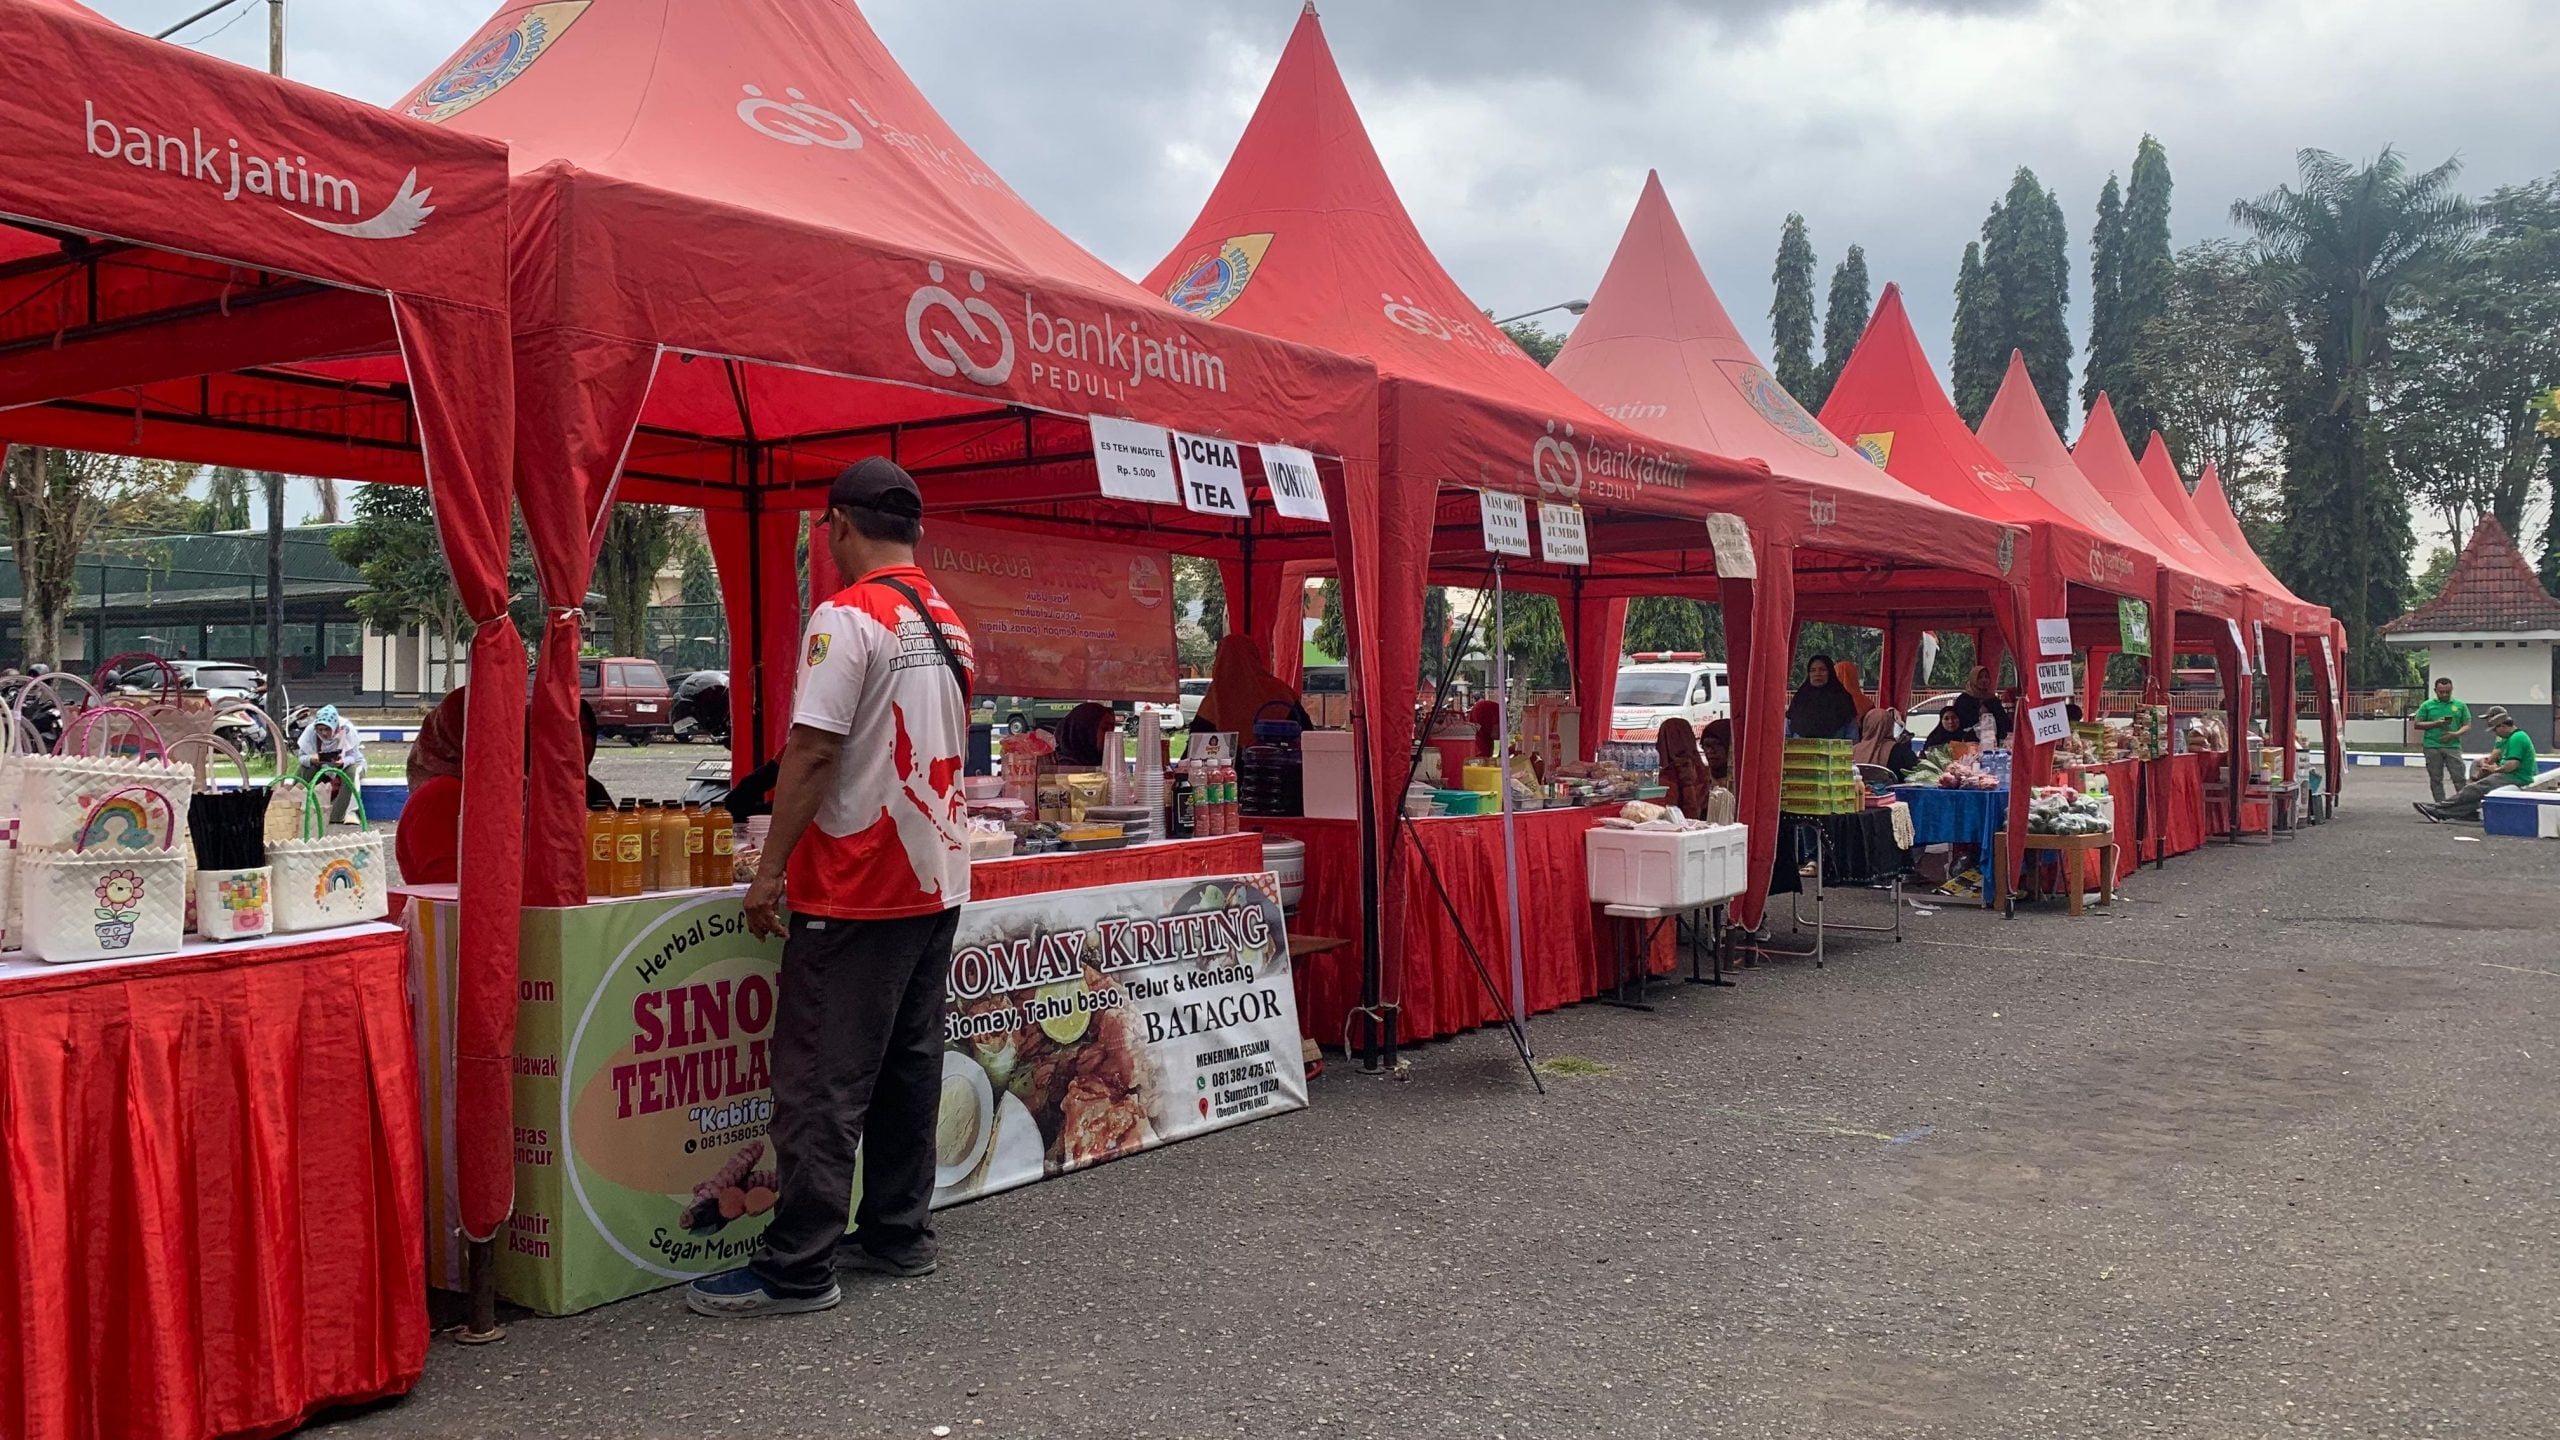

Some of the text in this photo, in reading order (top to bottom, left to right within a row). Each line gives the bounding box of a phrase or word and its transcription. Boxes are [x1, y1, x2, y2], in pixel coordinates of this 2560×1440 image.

[84, 100, 361, 216] bankjatim
[1025, 292, 1227, 393] bankjatim
[1030, 362, 1125, 402] PEDULI
[1101, 441, 1166, 458] ES TEH WAGITEL
[1178, 436, 1237, 470] OCHA
[1587, 434, 1688, 491] bankjatim
[1117, 464, 1156, 478] Rp. 5.000
[1265, 460, 1322, 500] WONTON
[1190, 480, 1236, 510] TEA
[1588, 479, 1635, 501] PEDULI
[1490, 513, 1518, 529] AYAM
[1556, 510, 1581, 526] TEH
[1488, 533, 1527, 548] Rp:10.000
[1547, 526, 1580, 540] JUMBO
[1547, 542, 1584, 557] Rp:5000
[2037, 708, 2056, 720] NASI
[2038, 724, 2061, 737] PECEL
[636, 911, 745, 984] Herbal Sof
[946, 905, 1268, 1003] OMAY KRITING
[518, 980, 554, 1001] om
[1024, 997, 1072, 1023] Tahu
[1076, 985, 1123, 1014] baso,
[1125, 975, 1168, 1001] Telur
[1173, 974, 1185, 992] &
[1187, 964, 1254, 991] Kentang
[633, 972, 782, 1055] SINO
[1143, 988, 1282, 1044] BATAGOR
[512, 1053, 557, 1077] ulawak
[1196, 1040, 1270, 1068] MENERIMA PESANAN
[611, 1039, 774, 1119] TEMULA
[1248, 1063, 1264, 1079] 475
[1224, 1084, 1259, 1104] Sumatra
[1259, 1078, 1280, 1095] 102A
[1216, 1105, 1239, 1119] (Depan
[514, 1126, 547, 1146] eras
[509, 1229, 550, 1259] Asem
[649, 1224, 769, 1264] Segar Menye
